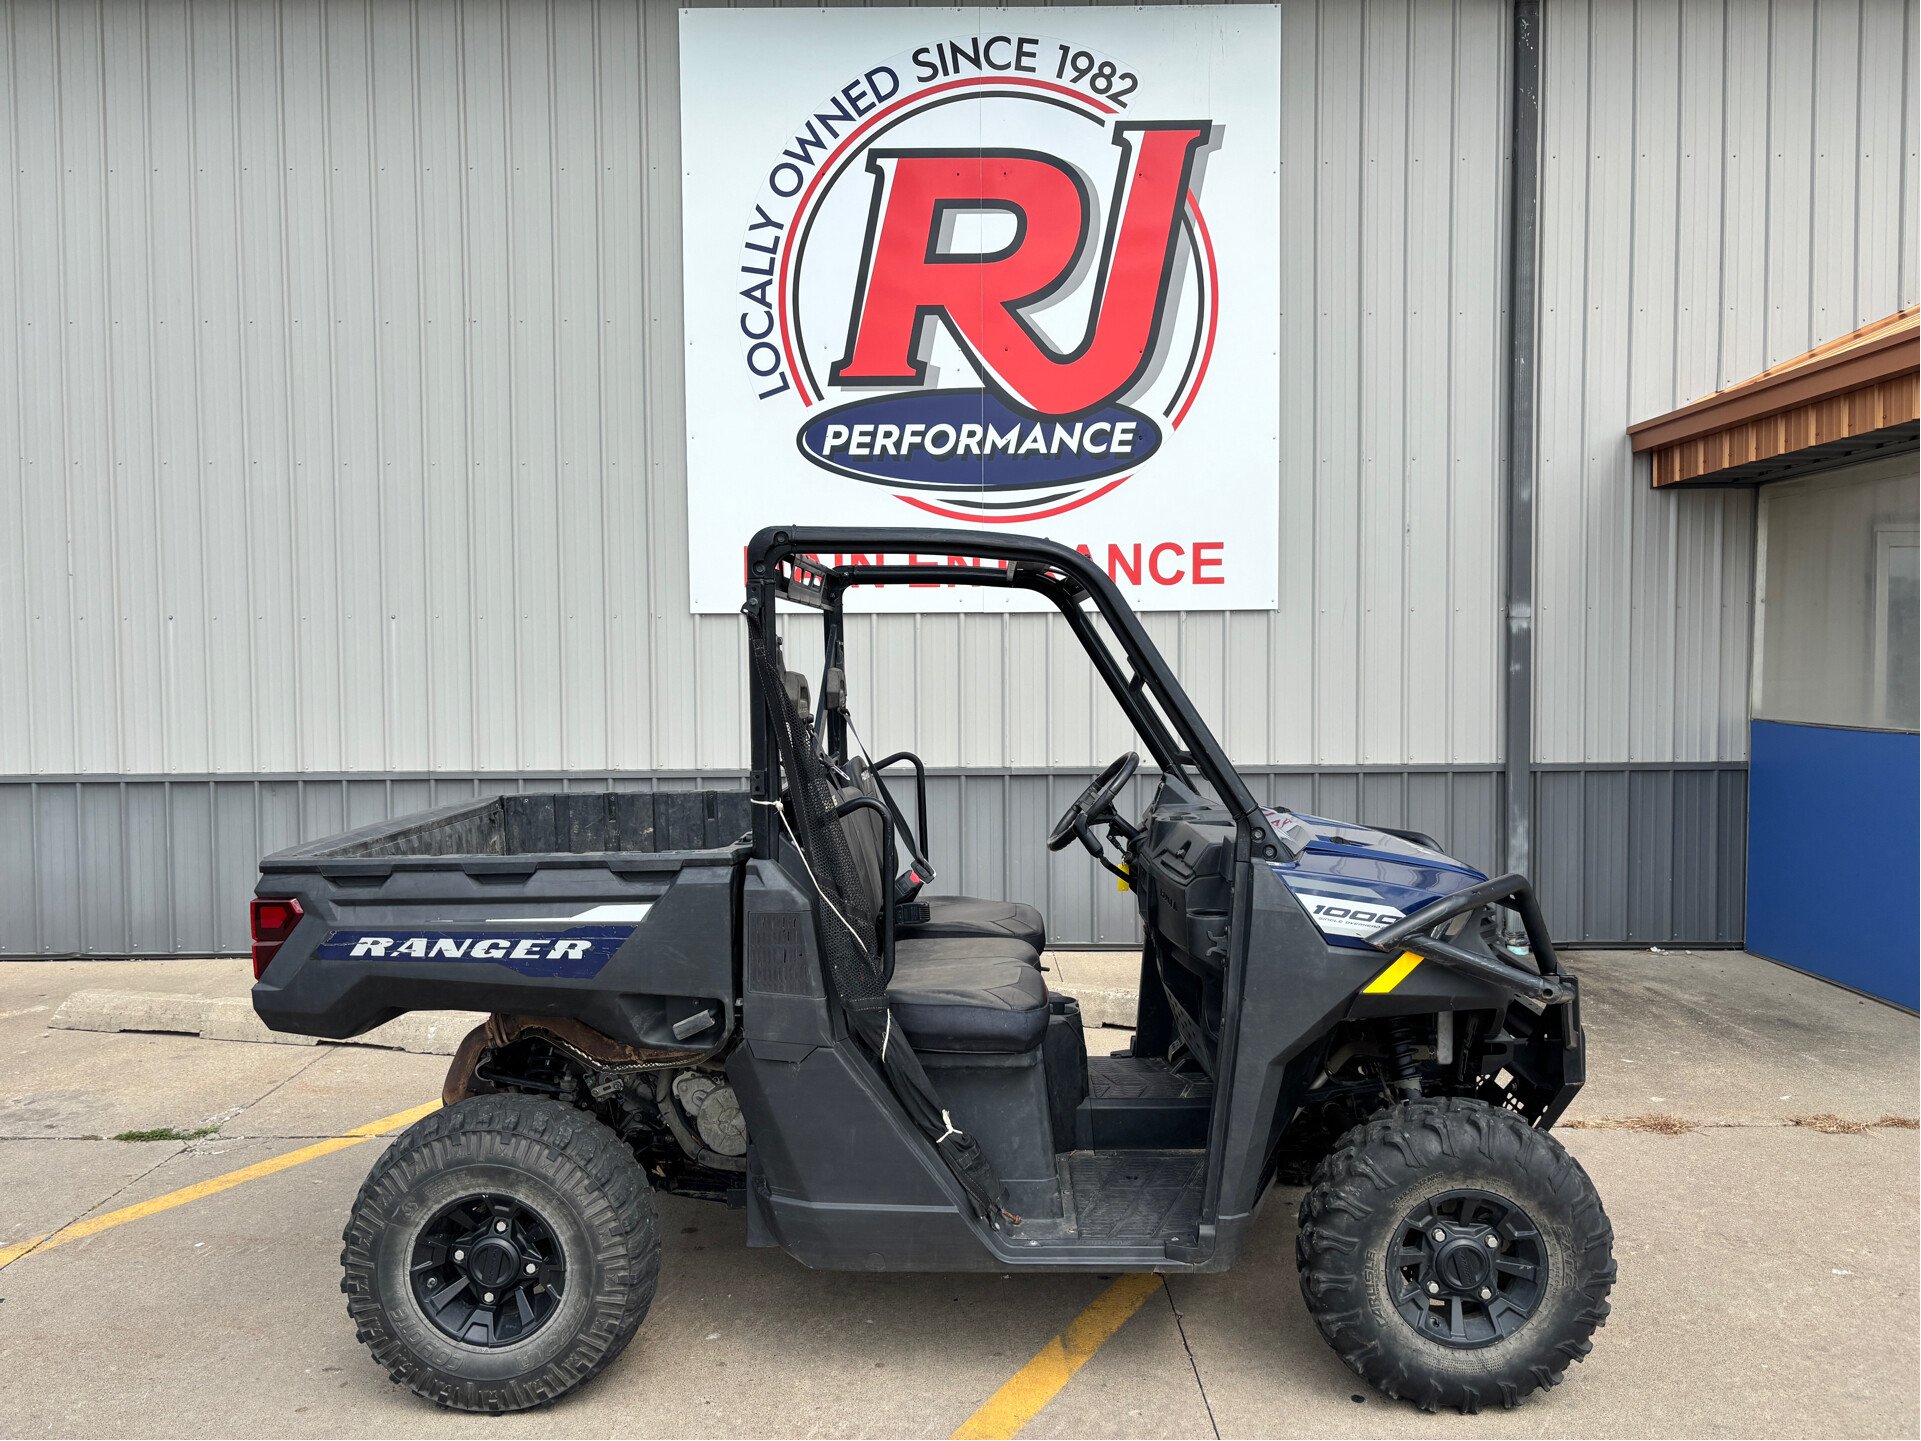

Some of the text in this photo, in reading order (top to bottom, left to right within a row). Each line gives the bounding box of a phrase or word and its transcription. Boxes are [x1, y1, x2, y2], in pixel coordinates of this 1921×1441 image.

[740, 35, 1139, 400] LOCALLY OWNED SINCE 1982
[828, 119, 1213, 415] RJ
[821, 420, 1138, 456] PERFORMANCE
[349, 936, 593, 960] RANGER
